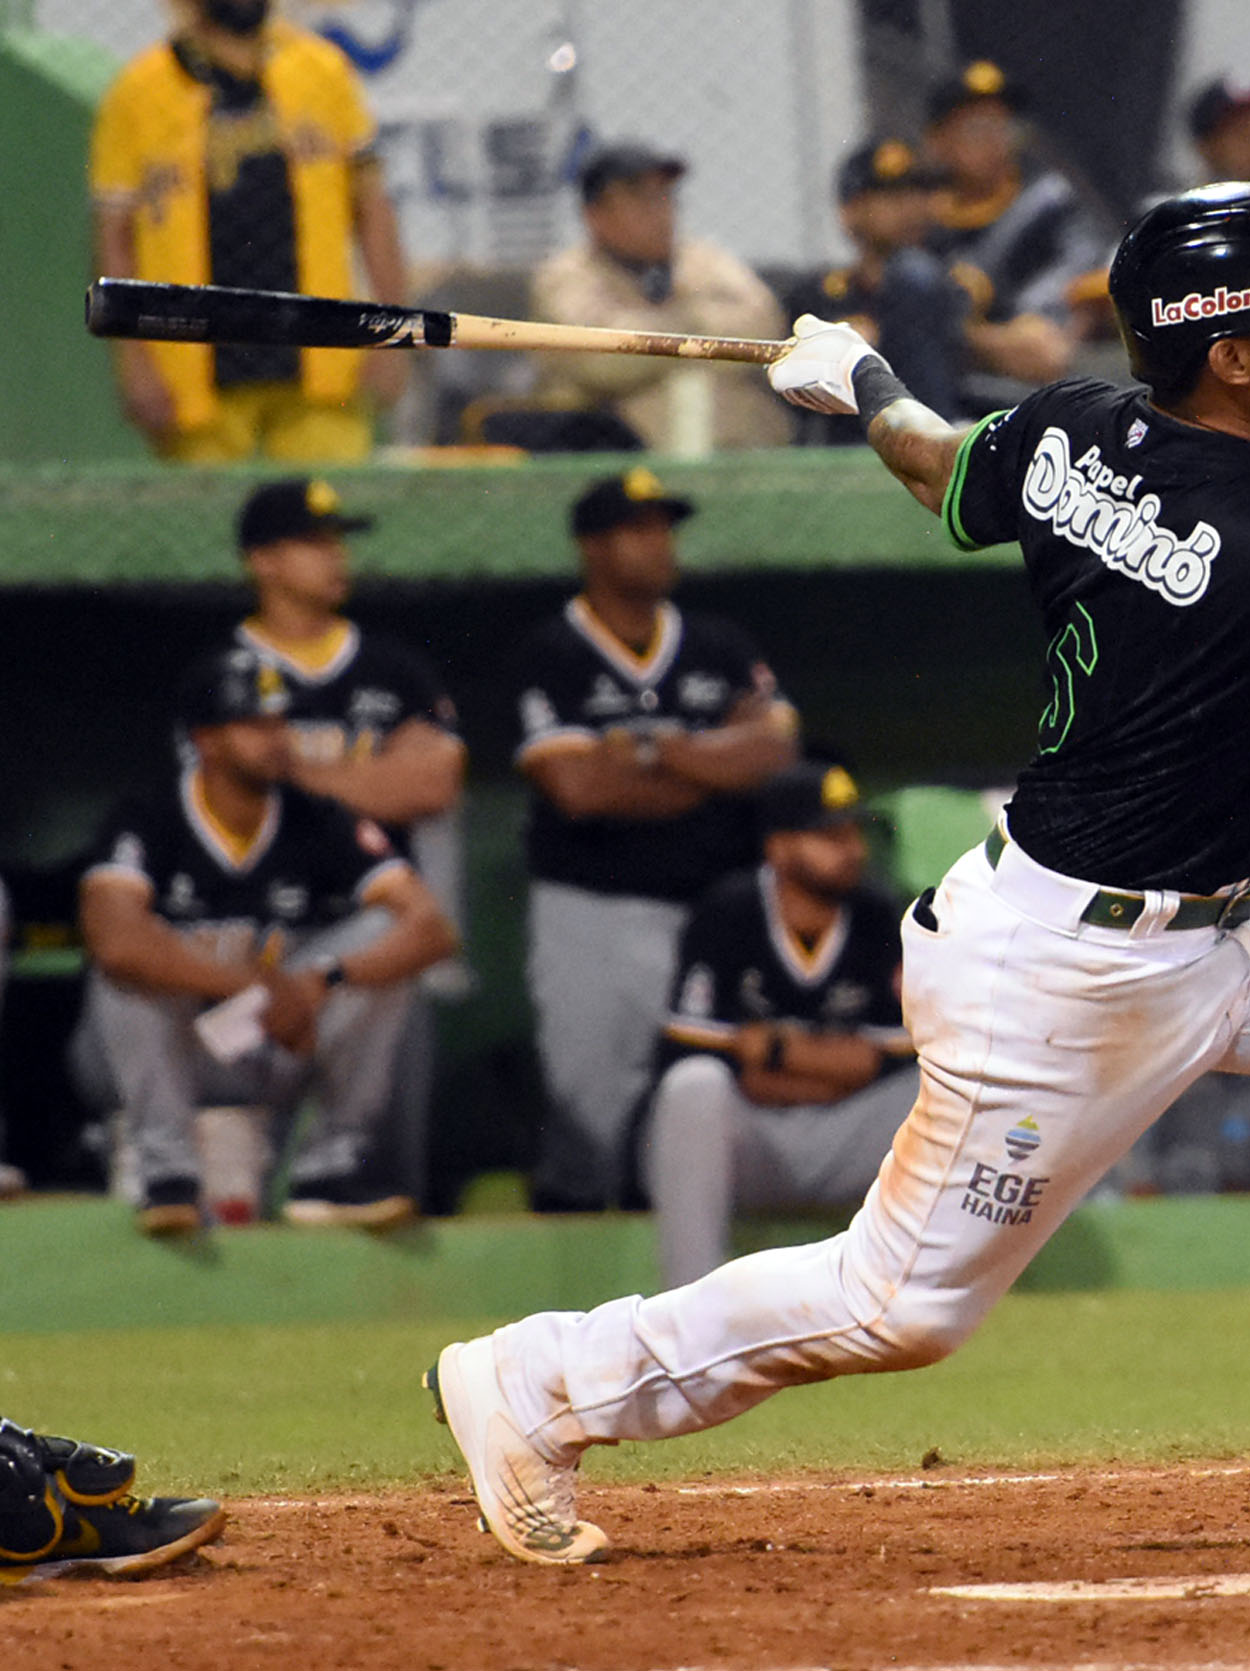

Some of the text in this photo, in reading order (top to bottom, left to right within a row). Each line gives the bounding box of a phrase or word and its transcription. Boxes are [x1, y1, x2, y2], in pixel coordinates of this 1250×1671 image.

[1074, 444, 1144, 500] Papel
[1022, 426, 1221, 606] Dominó
[961, 1192, 1033, 1226] HAINA
[967, 1161, 1051, 1208] EGE
